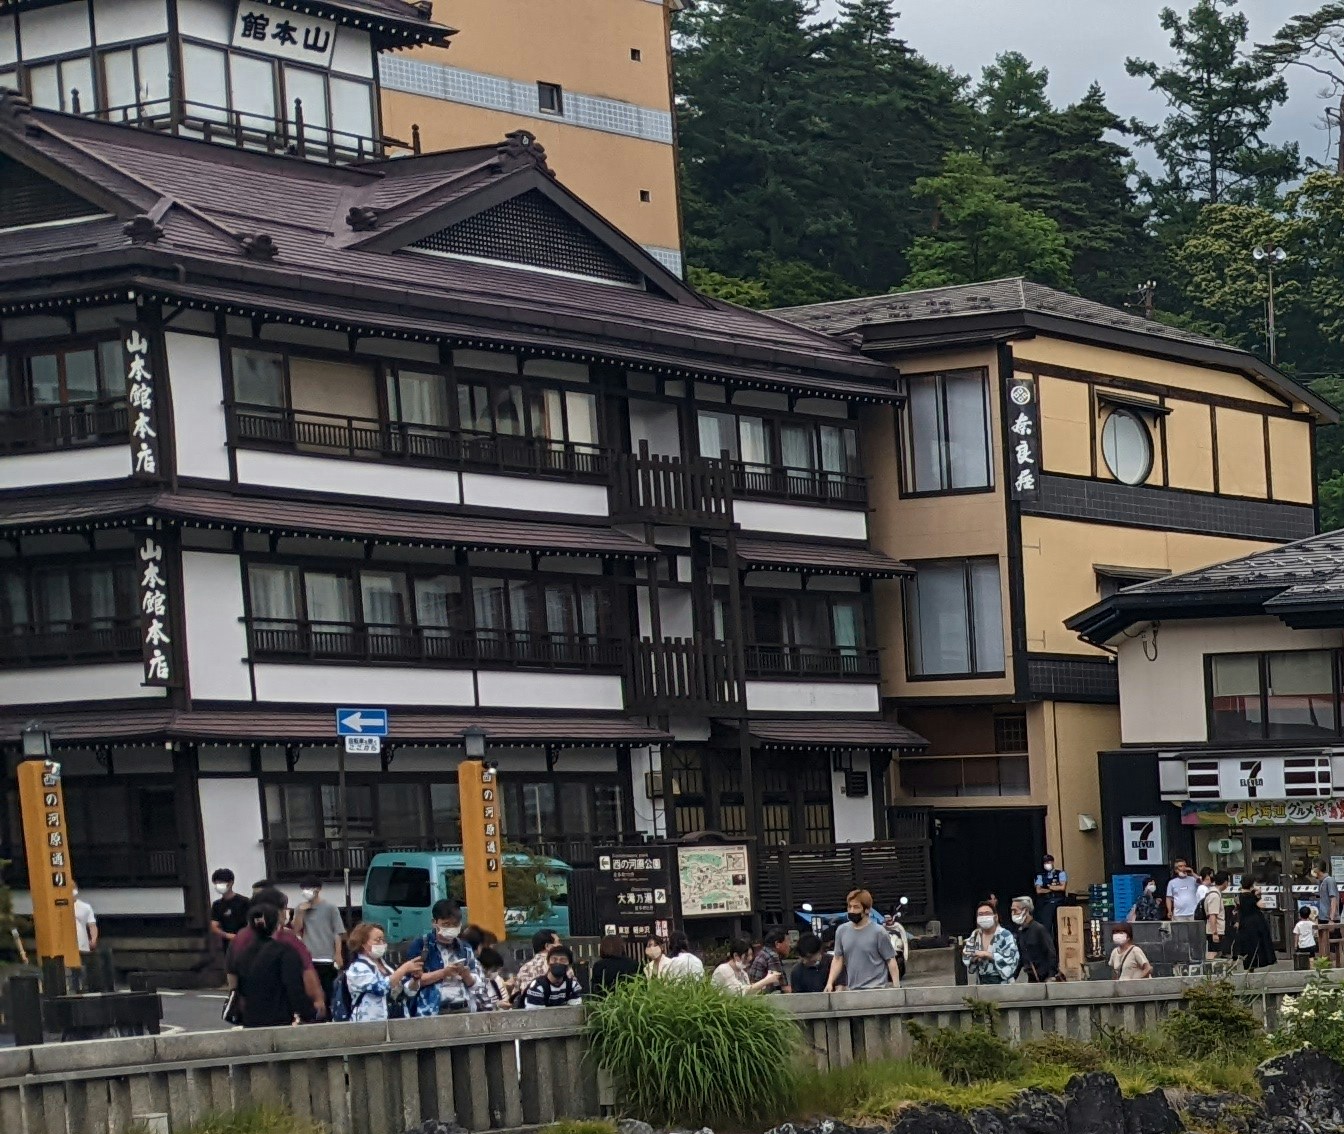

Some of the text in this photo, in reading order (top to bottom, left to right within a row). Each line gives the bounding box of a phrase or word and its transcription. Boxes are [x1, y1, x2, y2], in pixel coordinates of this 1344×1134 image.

[126, 330, 157, 474] 山本館本店
[140, 538, 171, 679] 山本館本店
